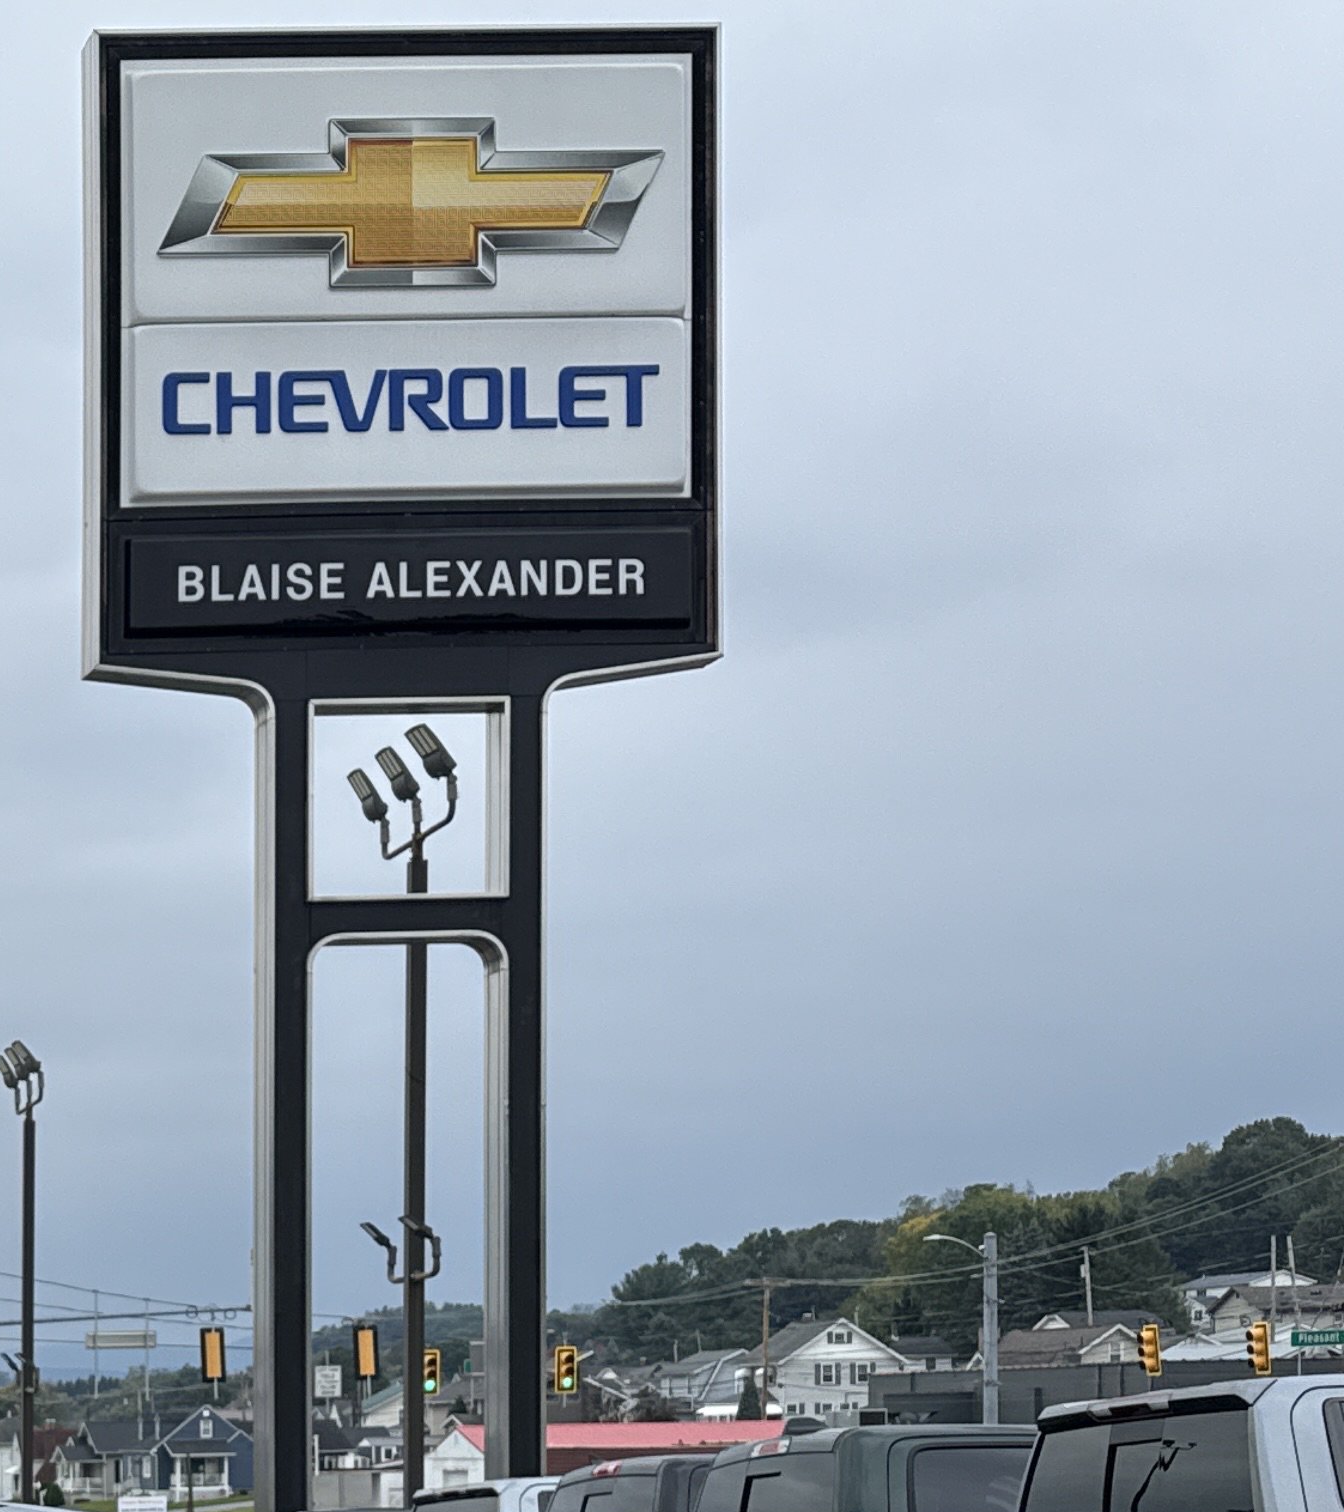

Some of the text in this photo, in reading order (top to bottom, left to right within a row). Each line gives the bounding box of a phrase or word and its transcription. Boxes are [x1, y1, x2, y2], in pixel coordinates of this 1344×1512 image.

[162, 365, 659, 434] CHEVROLET
[177, 558, 645, 602] BLAISE ALEXANDER
